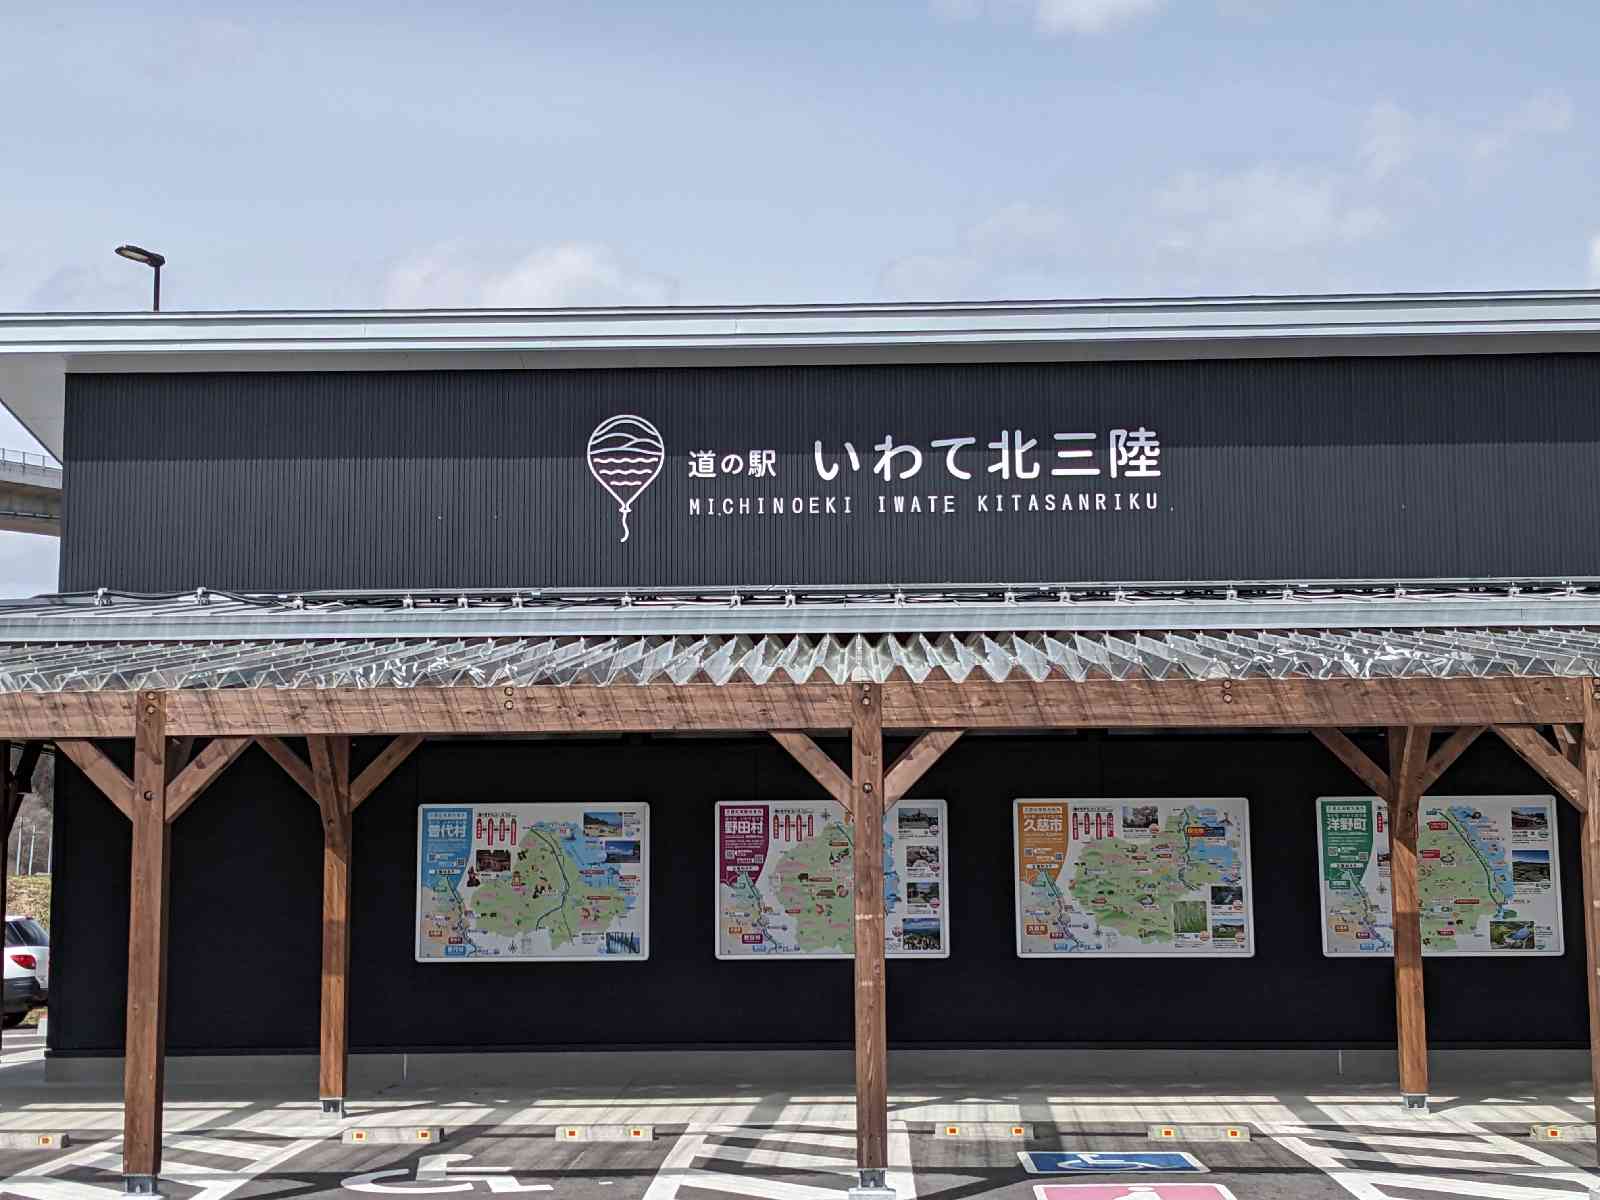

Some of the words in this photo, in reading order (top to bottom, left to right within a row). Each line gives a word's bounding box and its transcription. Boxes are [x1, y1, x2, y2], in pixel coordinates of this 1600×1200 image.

[688, 449, 777, 478] 道の駅
[814, 427, 1161, 482] いわて北三陸
[689, 496, 851, 516] MICHINOEKI
[878, 495, 955, 514] IWATE
[977, 492, 1157, 512] KITASANRIKU
